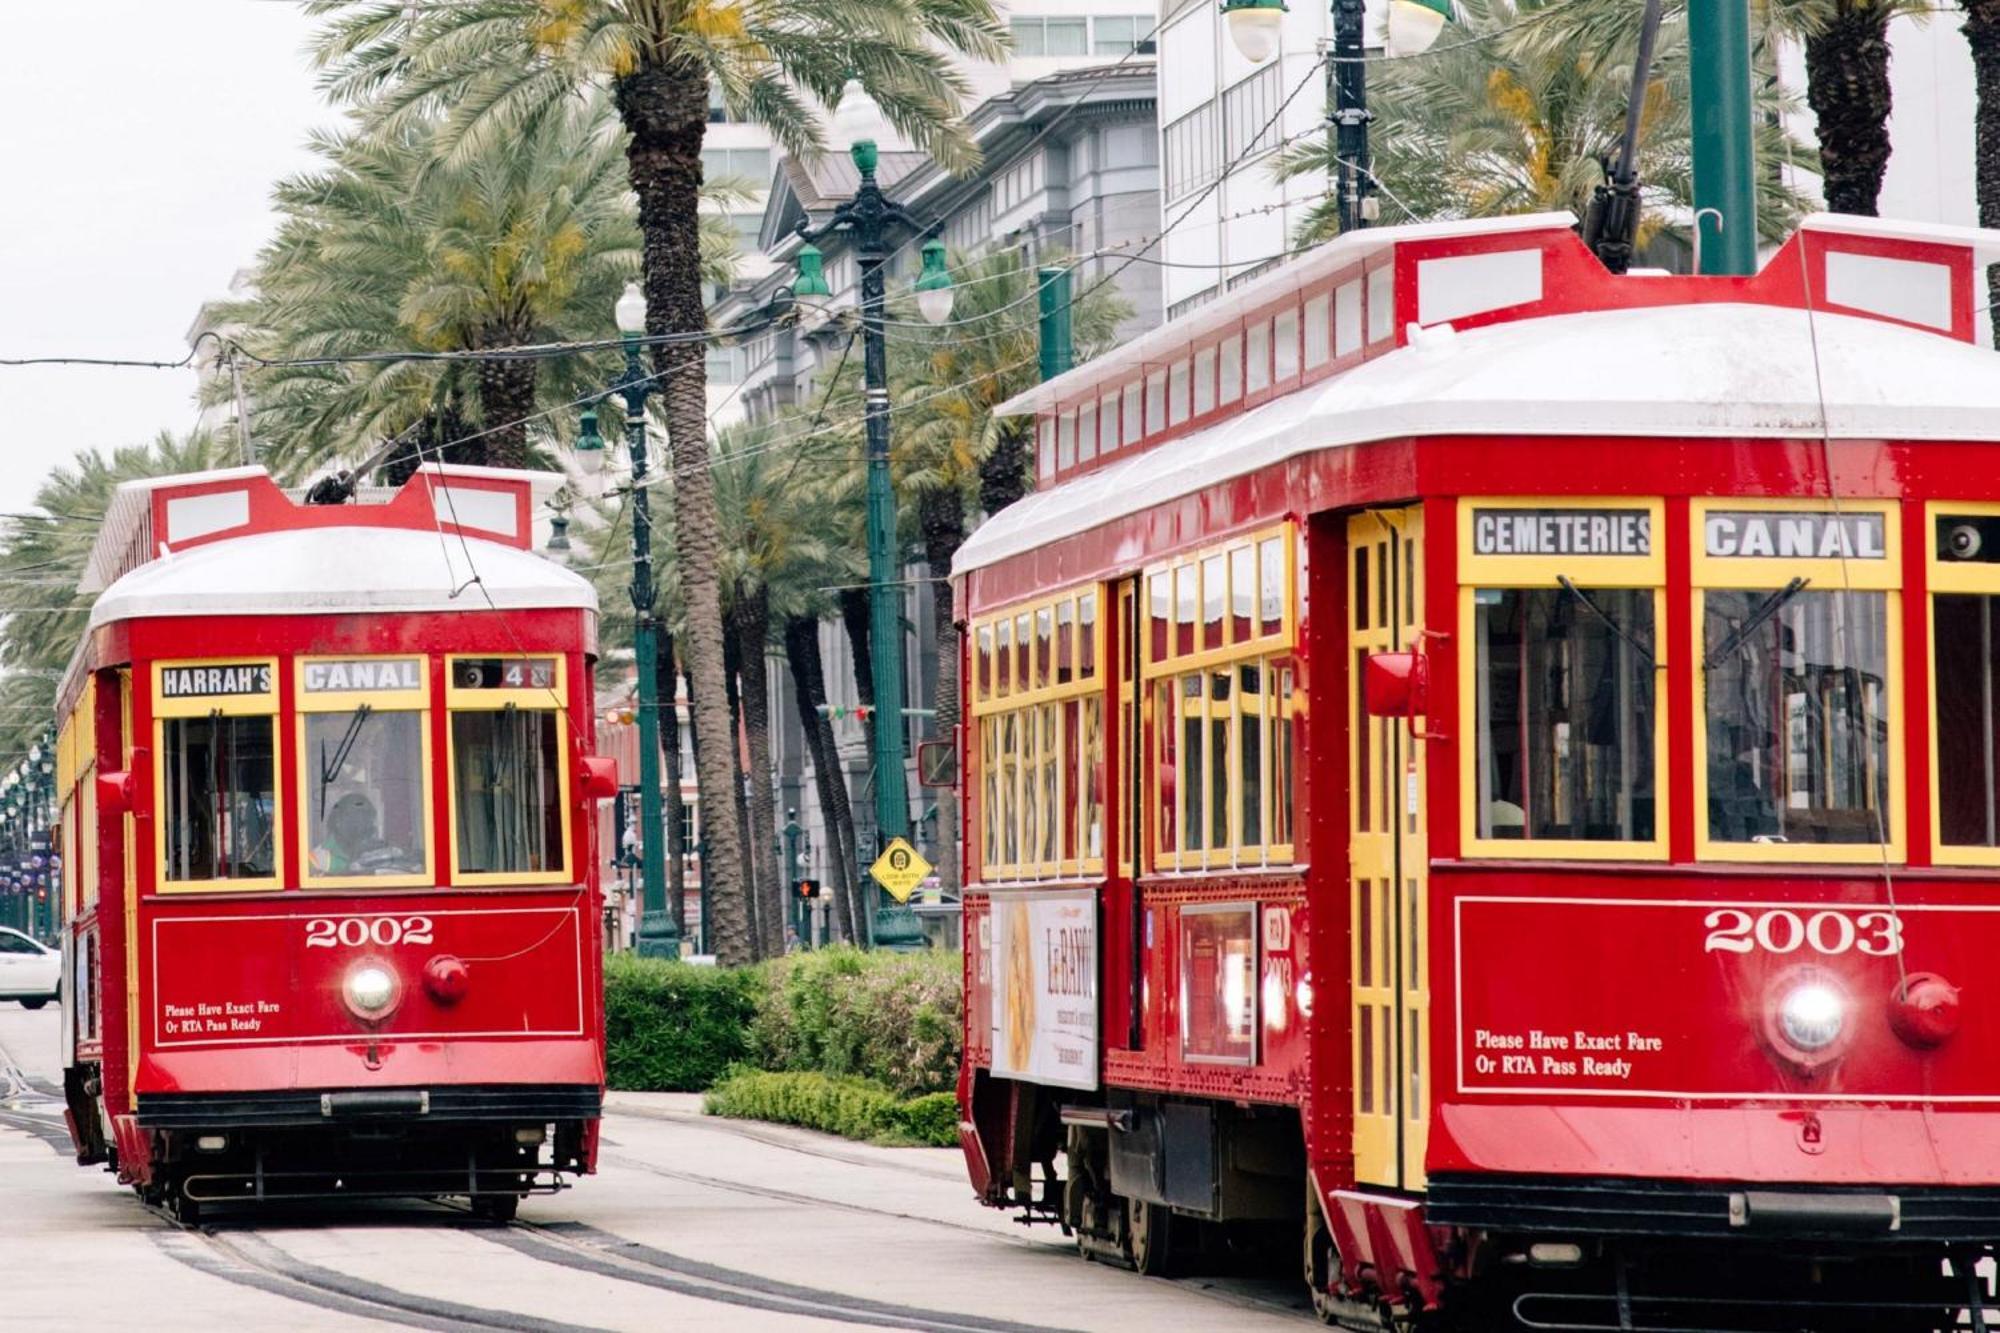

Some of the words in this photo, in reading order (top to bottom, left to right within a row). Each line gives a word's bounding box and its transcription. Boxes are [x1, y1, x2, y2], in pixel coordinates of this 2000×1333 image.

[1477, 515, 1650, 554] CEMETERIES
[1705, 518, 1885, 557] CANAL
[163, 666, 271, 695] HARRAH'S
[305, 663, 419, 690] CANAL
[305, 916, 433, 948] 2002
[1704, 909, 1904, 956] 2003
[165, 1004, 195, 1017] Please
[198, 1003, 222, 1015] Have
[226, 1002, 254, 1014] Exact
[258, 1000, 280, 1013] Fare
[165, 1020, 178, 1033] Or
[181, 1020, 203, 1032] RTA
[206, 1019, 228, 1031] Pass
[231, 1018, 261, 1031] Ready
[1475, 1029, 1524, 1049] Please
[1529, 1030, 1569, 1049] Have
[1574, 1031, 1621, 1050] Exact
[1627, 1032, 1663, 1051] Fare
[1475, 1054, 1496, 1073] Or
[1502, 1055, 1536, 1074] RTA
[1542, 1056, 1577, 1075] Pass
[1583, 1056, 1632, 1079] Ready
